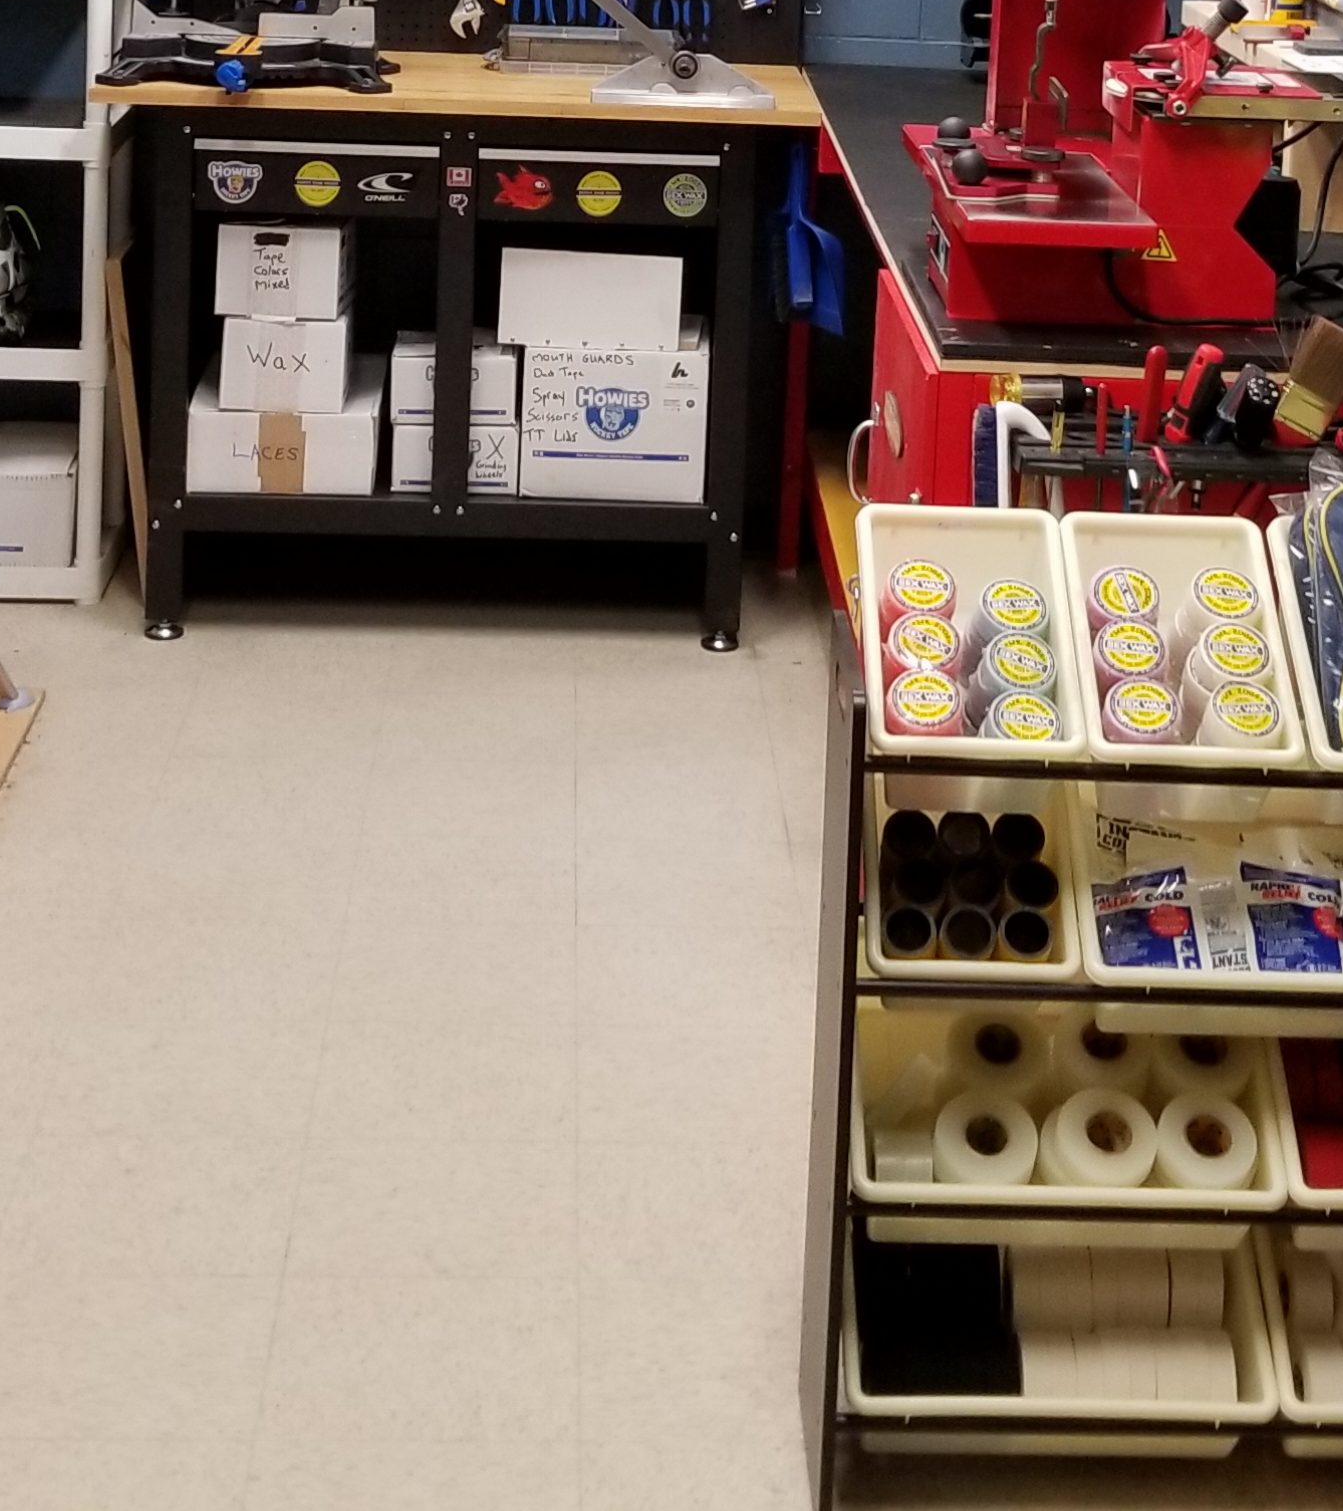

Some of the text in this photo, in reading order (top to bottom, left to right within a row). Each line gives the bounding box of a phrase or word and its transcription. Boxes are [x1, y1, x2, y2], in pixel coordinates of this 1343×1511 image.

[211, 164, 261, 179] HOWIES
[365, 194, 405, 202] O'NEILL
[254, 248, 286, 264] Tape
[247, 342, 310, 373] Wax
[532, 353, 635, 366] MOUTH GUARDS
[532, 387, 565, 407] Spray
[576, 386, 650, 409] HOWIES
[526, 407, 579, 424] Scissors
[523, 428, 545, 442] TT
[233, 442, 298, 461] LACES
[922, 579, 946, 589] WAX
[1224, 588, 1247, 598] WAX
[1014, 599, 1036, 608] WAX
[925, 636, 947, 653] WAX
[1130, 643, 1153, 653] WAX
[1234, 645, 1257, 654] WAX
[1021, 655, 1043, 670] WAX
[925, 694, 948, 702] WAX
[1144, 701, 1166, 710] WAX
[1243, 705, 1267, 714] WAX
[1026, 714, 1049, 725] WAX
[1145, 890, 1184, 902] COLD
